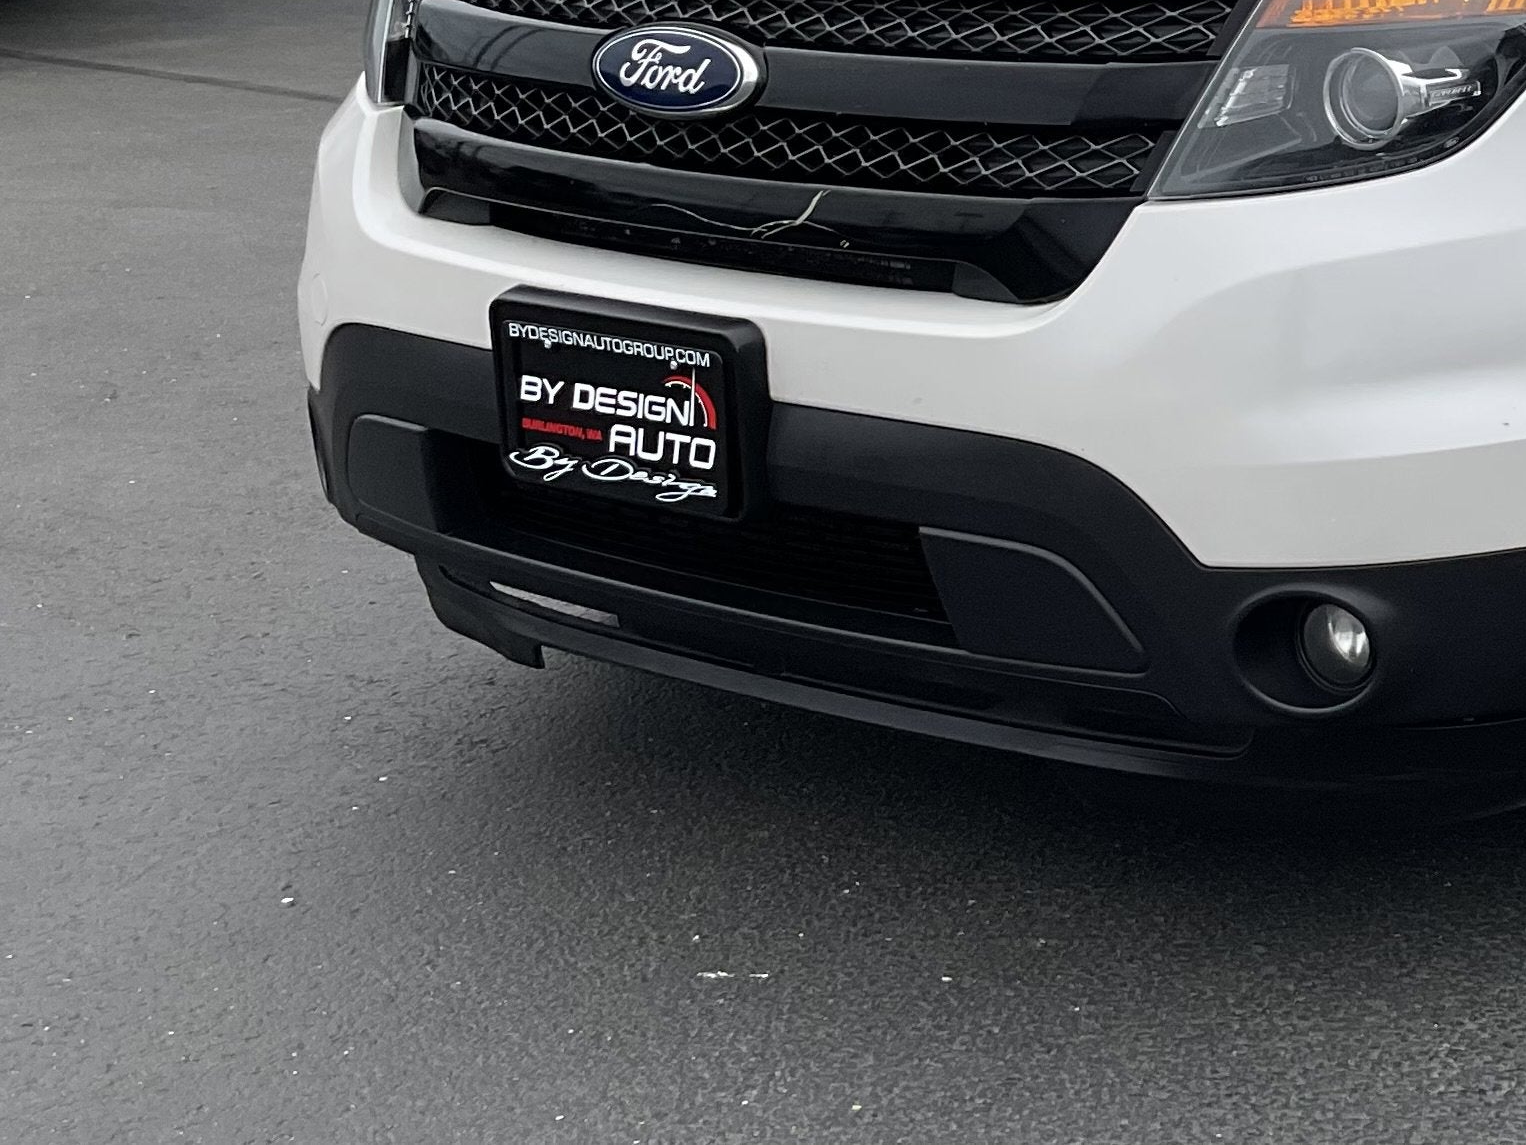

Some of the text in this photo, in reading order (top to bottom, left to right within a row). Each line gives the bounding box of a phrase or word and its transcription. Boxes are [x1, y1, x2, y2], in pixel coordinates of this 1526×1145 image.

[618, 37, 708, 95] Ford
[508, 322, 711, 368] BYDESIGNAUTOGROUP.COM
[520, 374, 691, 427] BY DESIGN
[609, 424, 716, 470] AUTO
[509, 445, 718, 503] By Design
